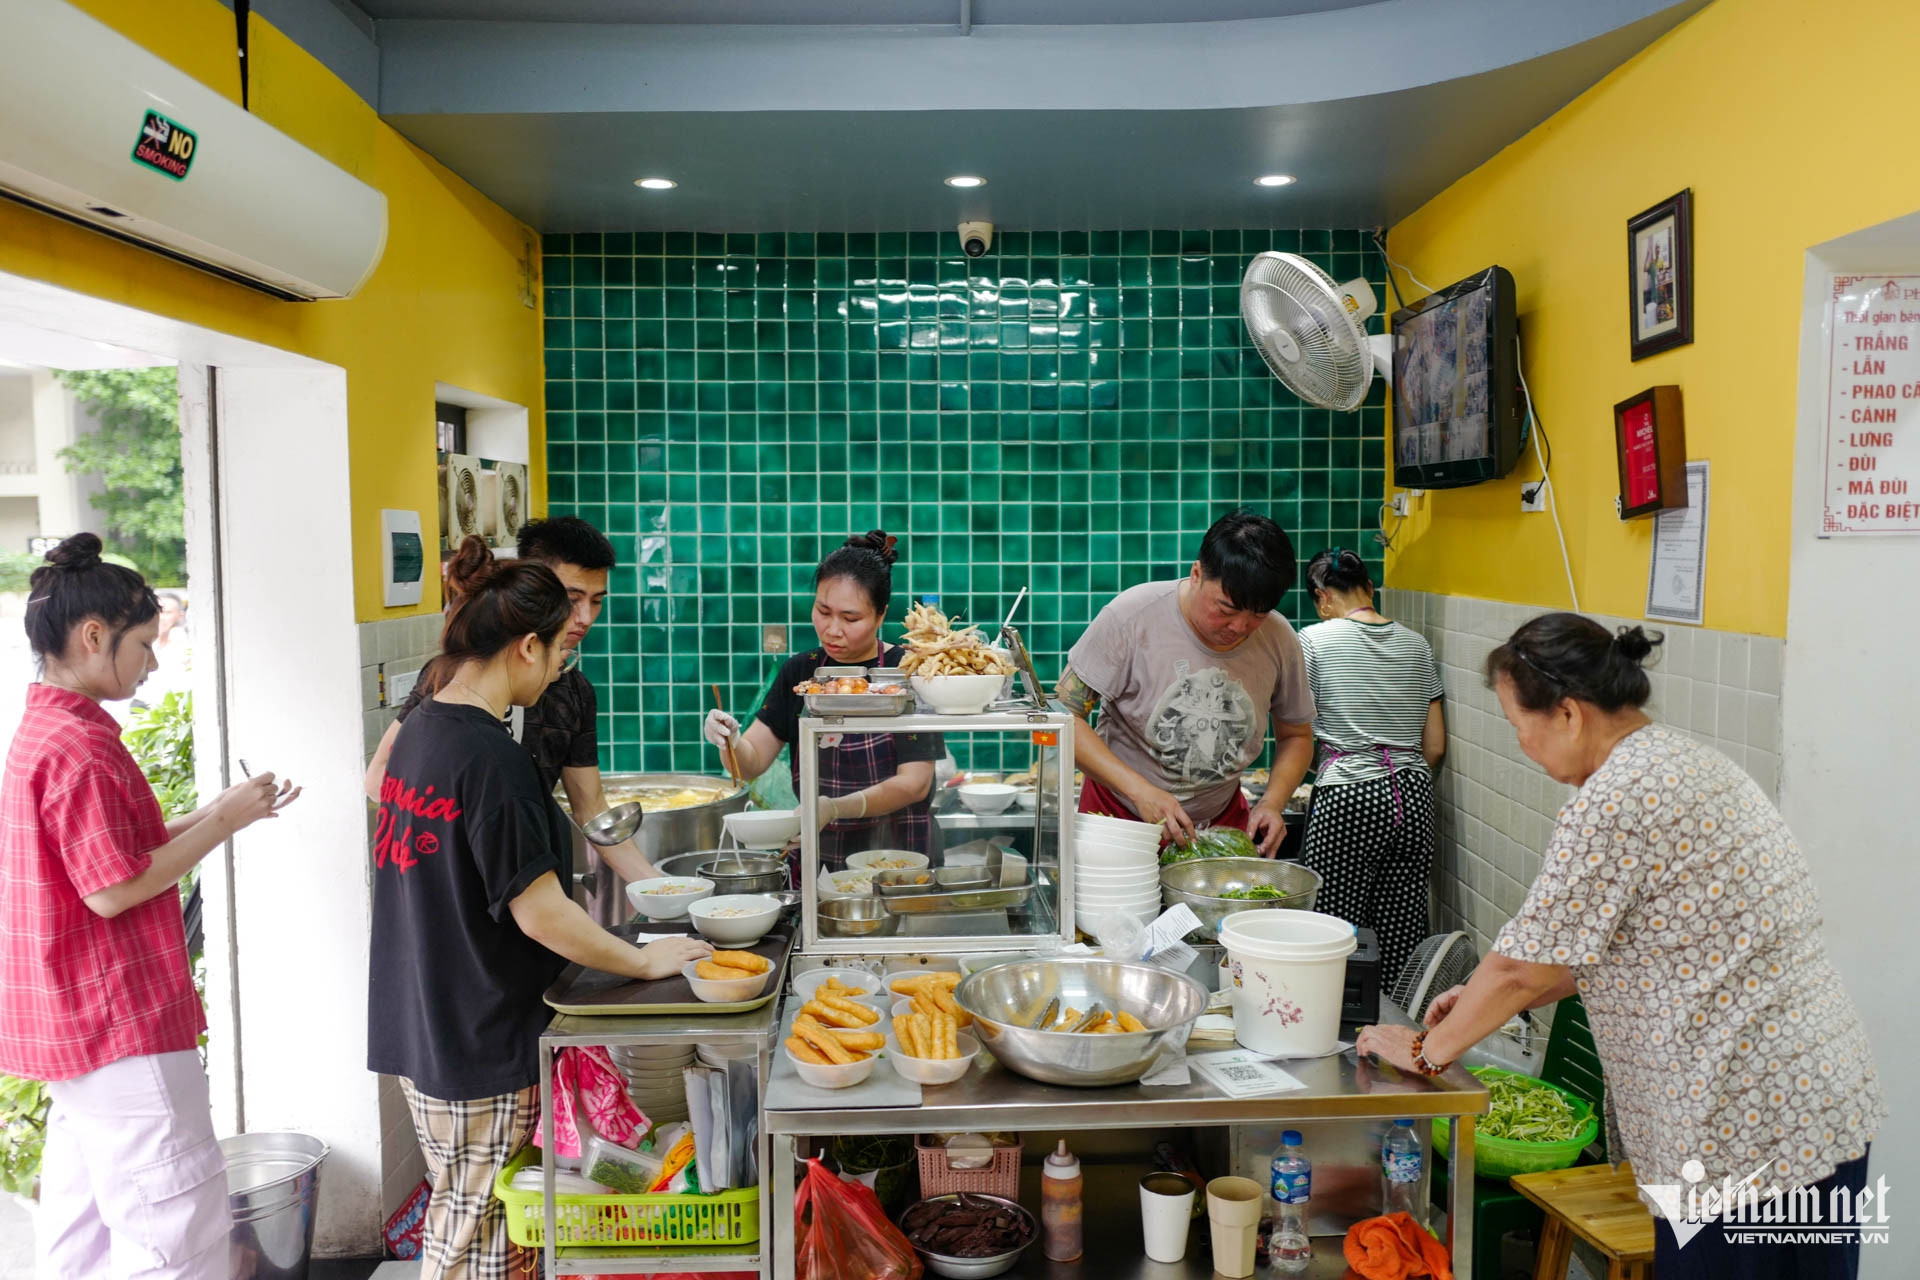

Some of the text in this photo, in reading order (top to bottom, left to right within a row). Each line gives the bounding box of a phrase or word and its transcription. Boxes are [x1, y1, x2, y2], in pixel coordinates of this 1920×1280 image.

[168, 129, 194, 159] NO
[136, 144, 187, 176] SMOKING
[1855, 330, 1908, 351] TRẮNG
[1852, 383, 1896, 399] PHAO
[1851, 405, 1896, 423] CÁNH
[1850, 431, 1893, 448] LƯNG
[1848, 453, 1876, 471] ĐÙI
[1848, 477, 1907, 495] MÁ ĐÙI
[1847, 500, 1920, 522] ĐẶC BIỆT
